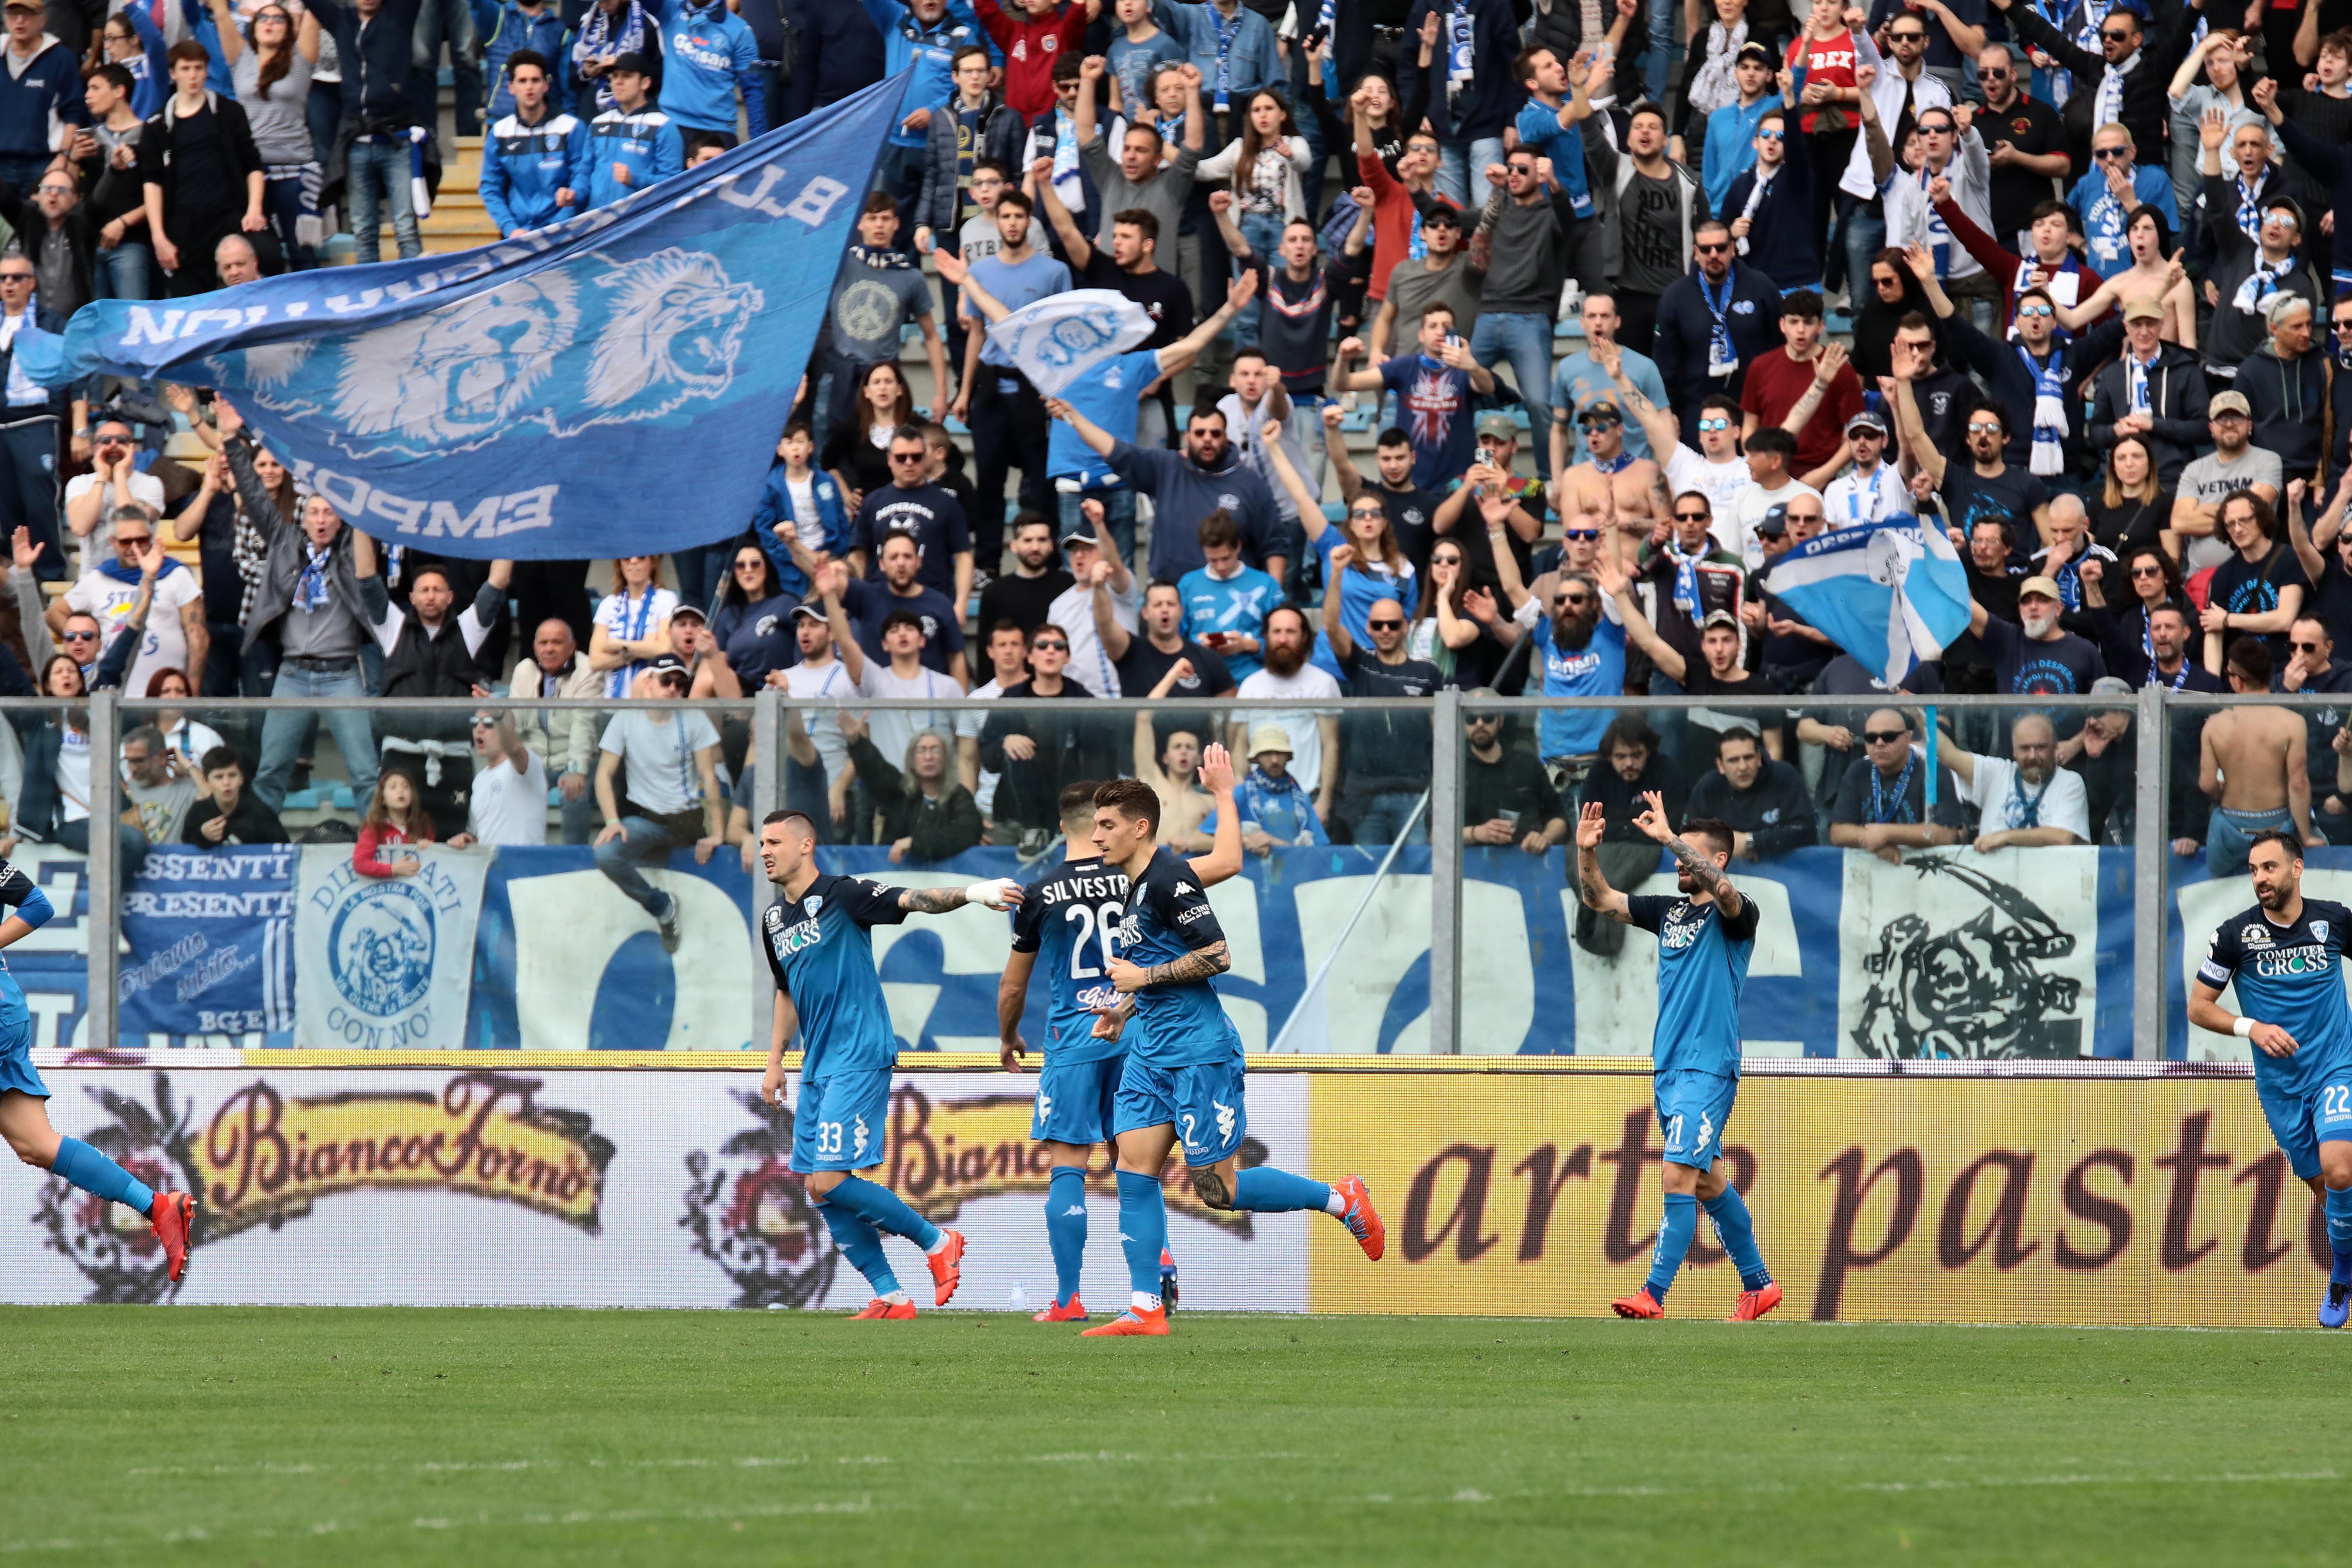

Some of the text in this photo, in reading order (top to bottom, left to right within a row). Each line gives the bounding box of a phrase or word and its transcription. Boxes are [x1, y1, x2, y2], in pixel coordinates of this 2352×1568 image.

[2197, 477, 2253, 496] VETNAM
[135, 853, 292, 881] SSENTI
[121, 891, 294, 918] PRESENTI
[773, 917, 819, 945] COMPUTER
[774, 925, 821, 961] GROSS
[1065, 901, 1125, 980] 26
[118, 930, 209, 1001] orniamo
[2257, 944, 2325, 960] COMPUTER
[2257, 953, 2328, 977] GROSS
[2325, 1085, 2351, 1116] 22
[818, 1121, 842, 1153] 33
[1183, 1114, 1199, 1147] 2
[1820, 1110, 2331, 1321] pasti
